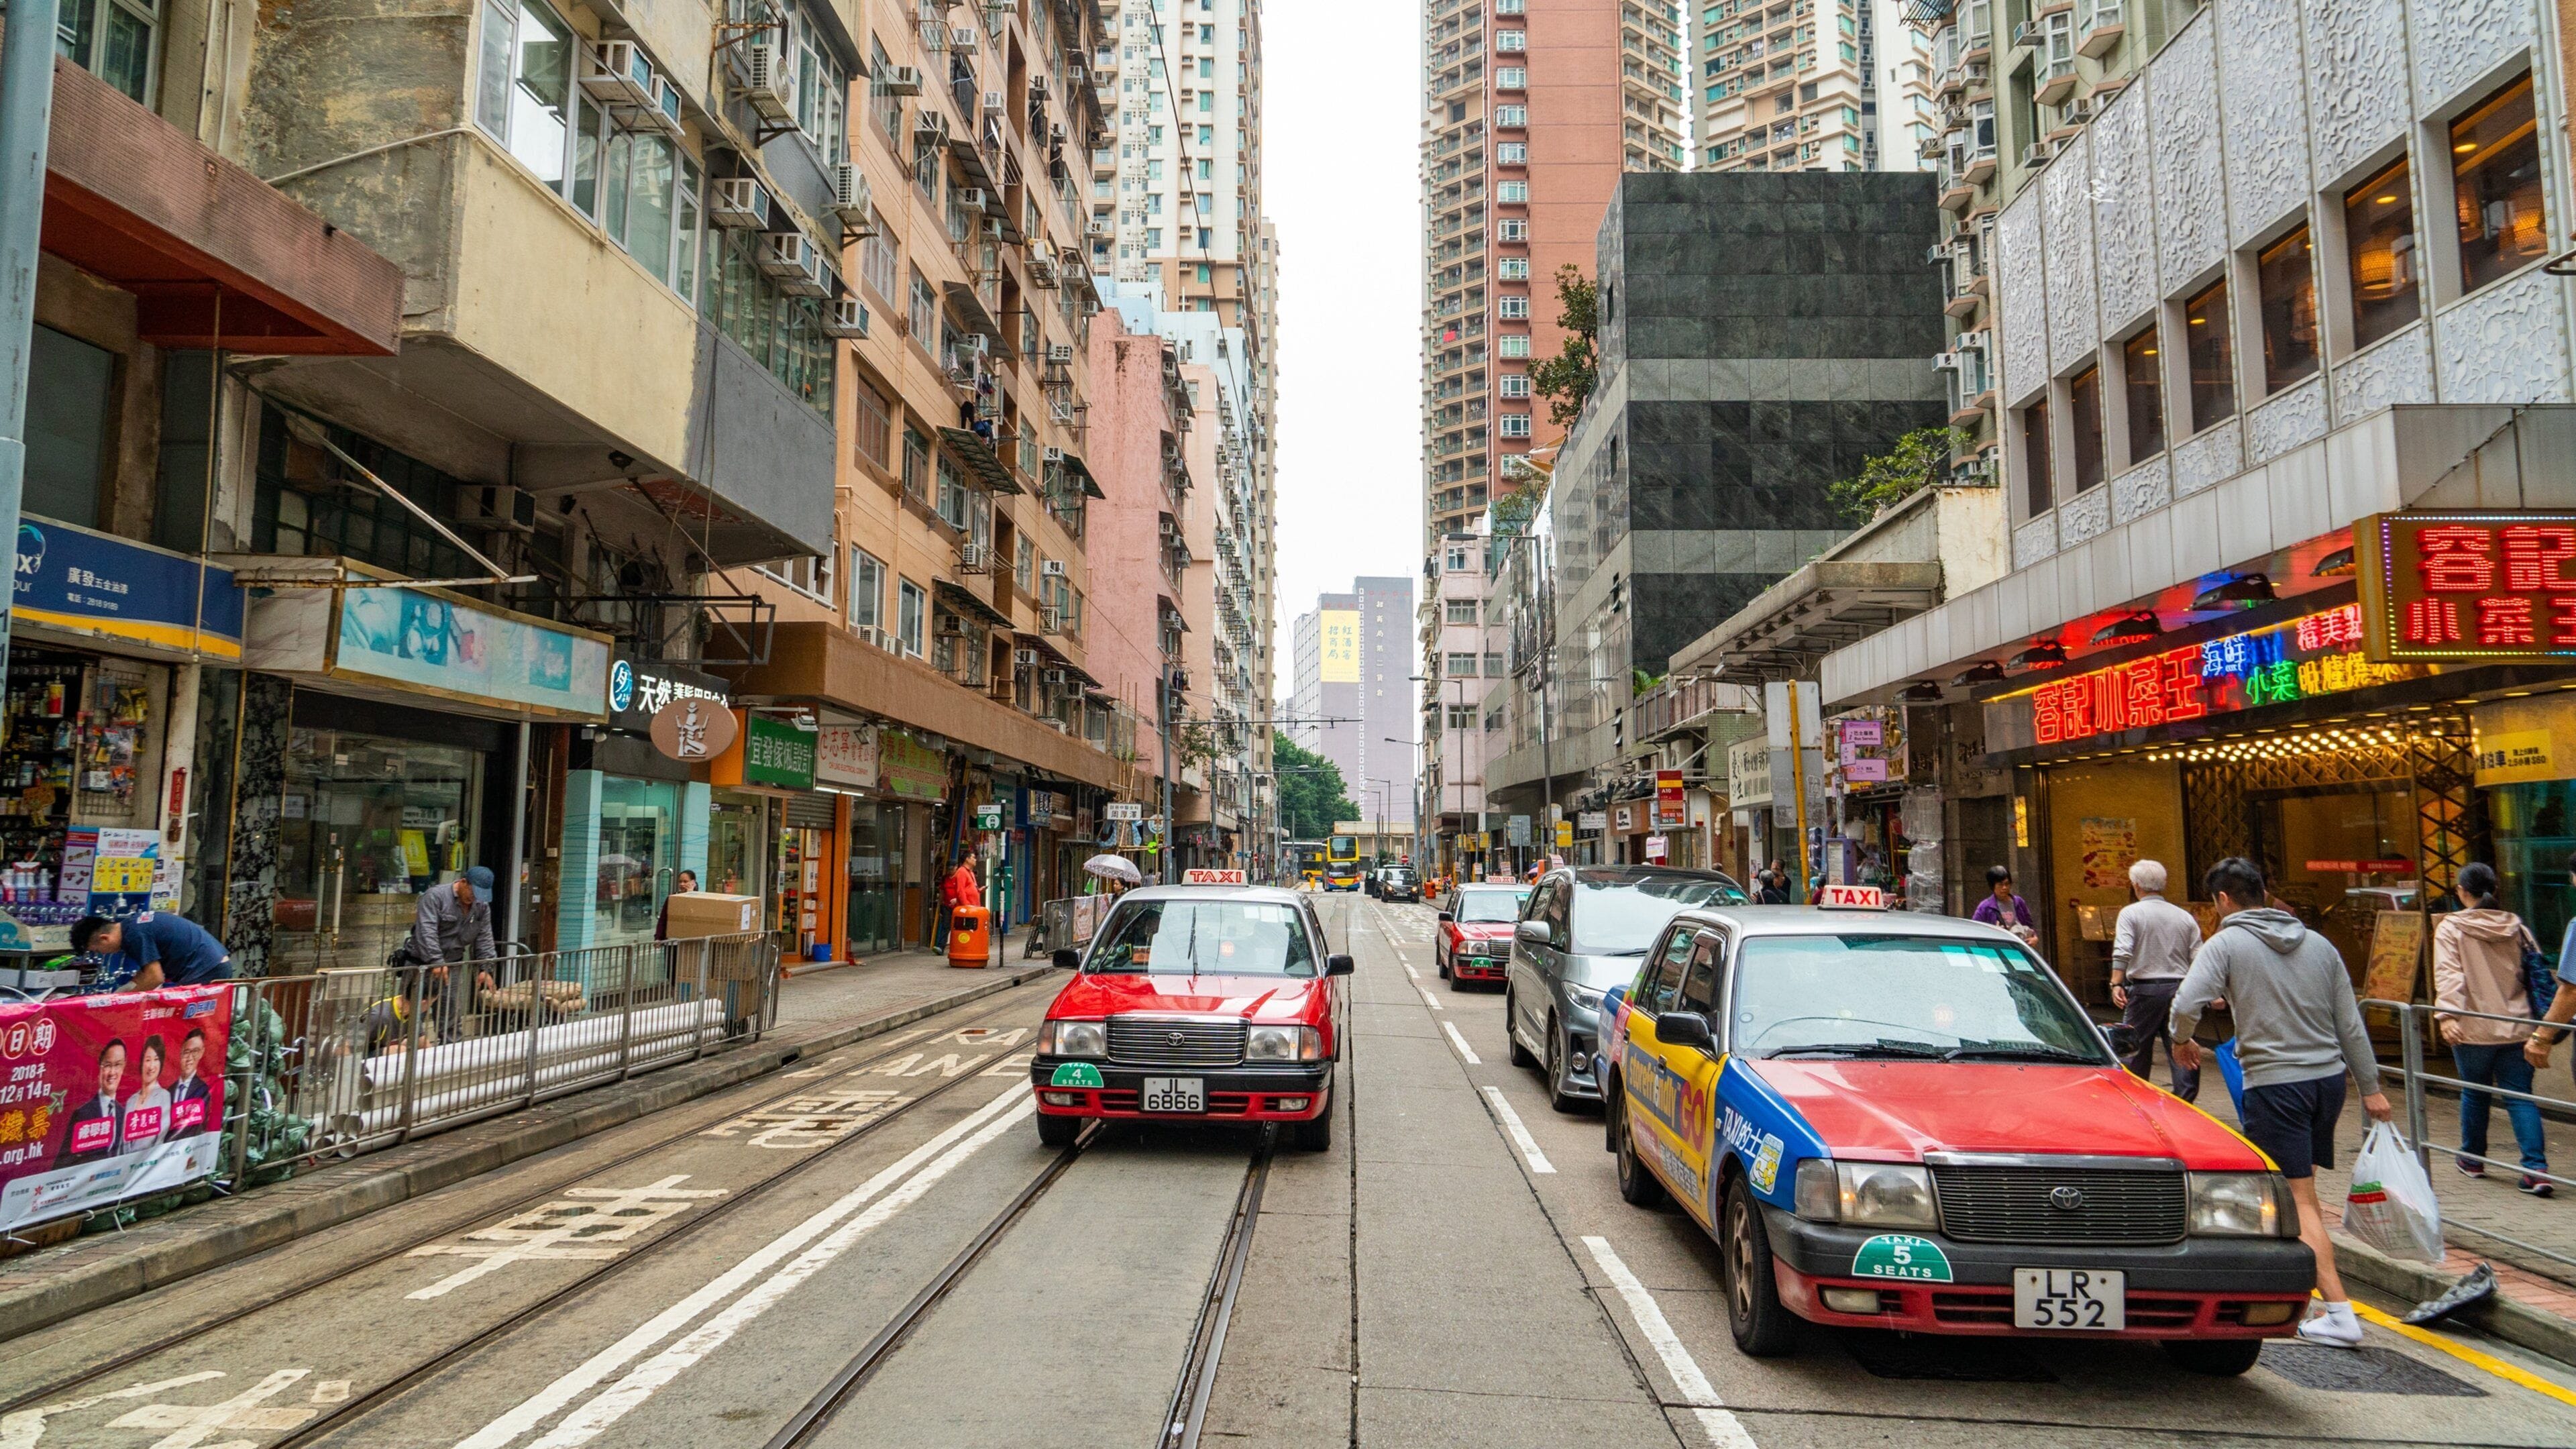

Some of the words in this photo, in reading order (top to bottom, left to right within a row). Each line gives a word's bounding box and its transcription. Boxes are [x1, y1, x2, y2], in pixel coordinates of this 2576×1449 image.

[2418, 525, 2576, 592] 容記
[2202, 634, 2247, 676] 海鮮
[2246, 660, 2298, 705] 小菜
[2033, 645, 2208, 745] 容記小菜王
[750, 733, 812, 775] 宜發傢俬設計
[1190, 870, 1242, 883] TAXI
[1831, 889, 1880, 906] TAXI
[9, 1021, 54, 1052] 日期
[881, 1028, 1036, 1046] TRA
[11, 1063, 47, 1083] 2018年
[1071, 1069, 1081, 1079] 4
[1161, 1079, 1186, 1094] JL
[1148, 1093, 1199, 1110] 6866
[1680, 1079, 1705, 1153] GO
[1881, 1236, 1921, 1247] TAXI
[1893, 1245, 1913, 1265] 5
[1872, 1264, 1932, 1279] SEATS
[2046, 1270, 2092, 1299] LR
[2033, 1298, 2106, 1328] 552
